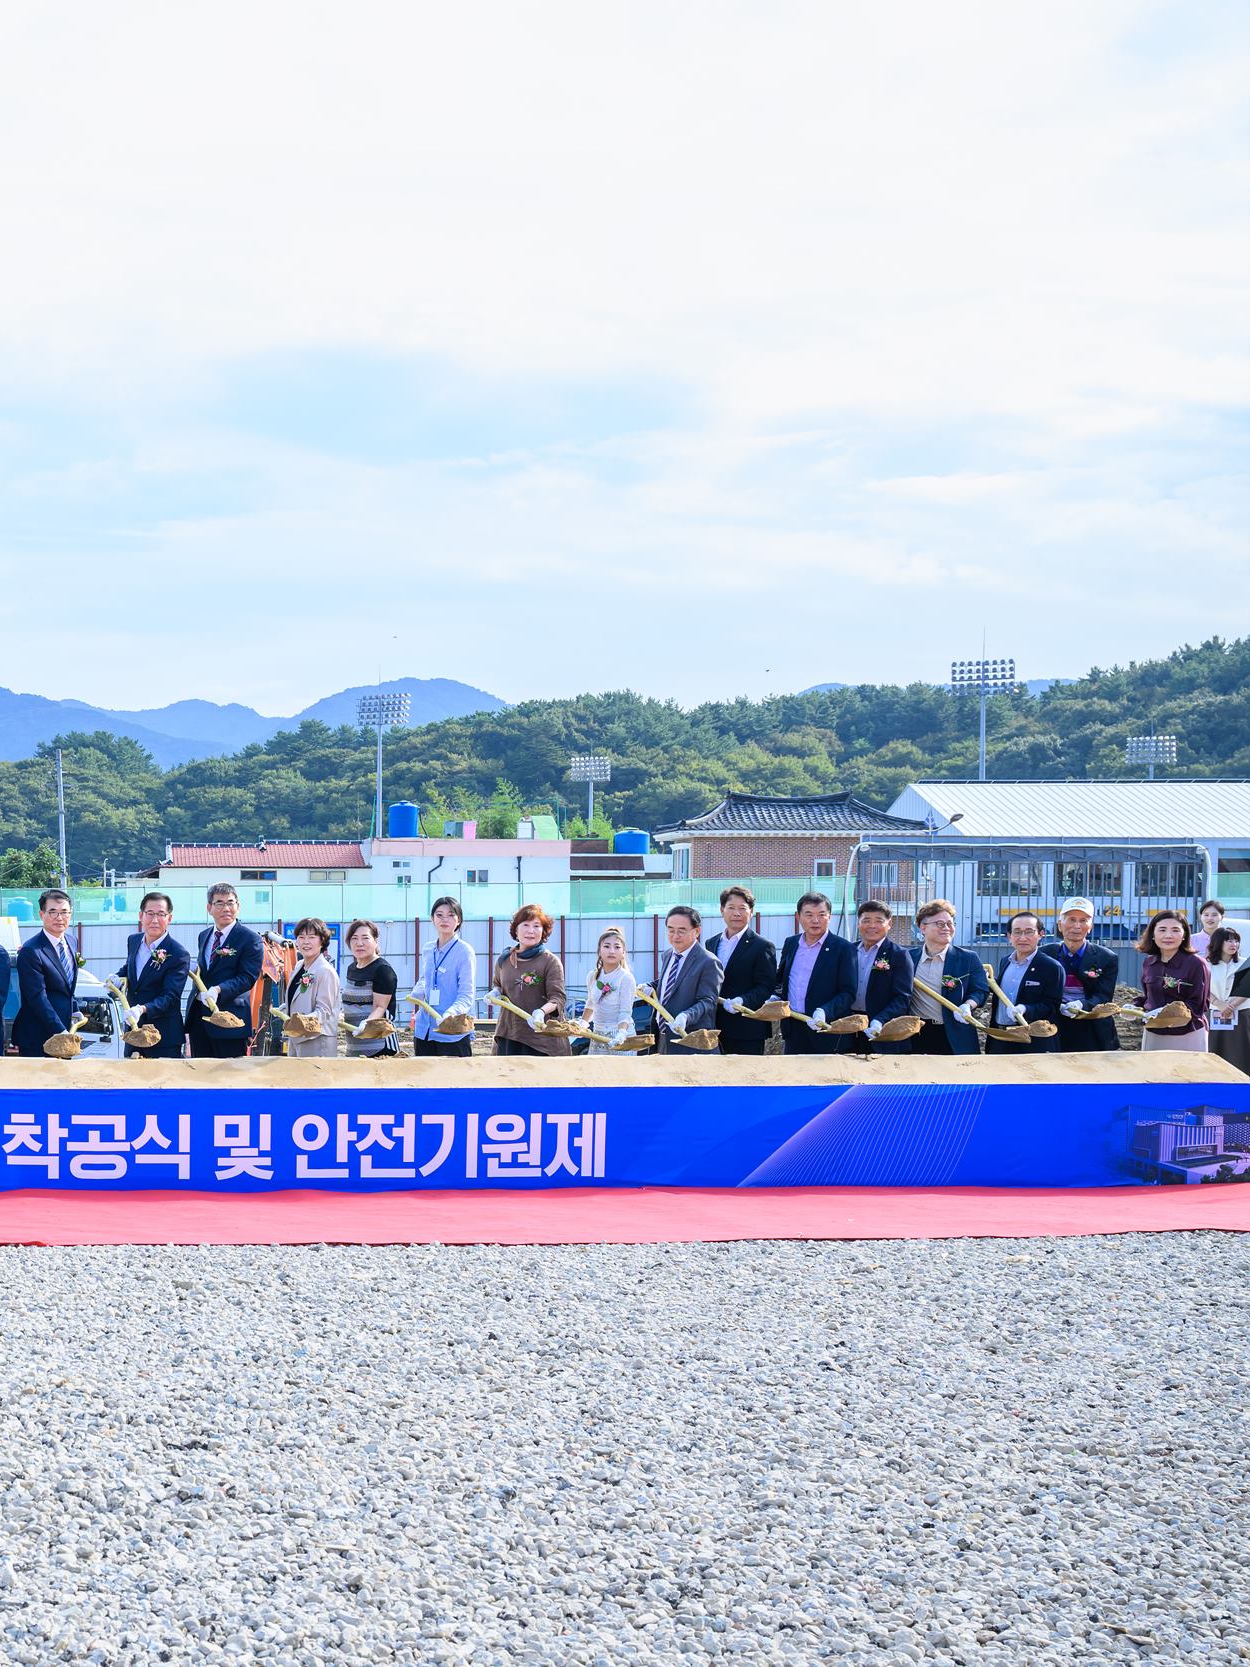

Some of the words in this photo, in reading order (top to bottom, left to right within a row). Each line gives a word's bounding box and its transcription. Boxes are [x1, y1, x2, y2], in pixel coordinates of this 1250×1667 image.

[1, 1113, 191, 1180] 착공식
[213, 1113, 275, 1181] 및
[291, 1112, 607, 1179] 안전기원제
